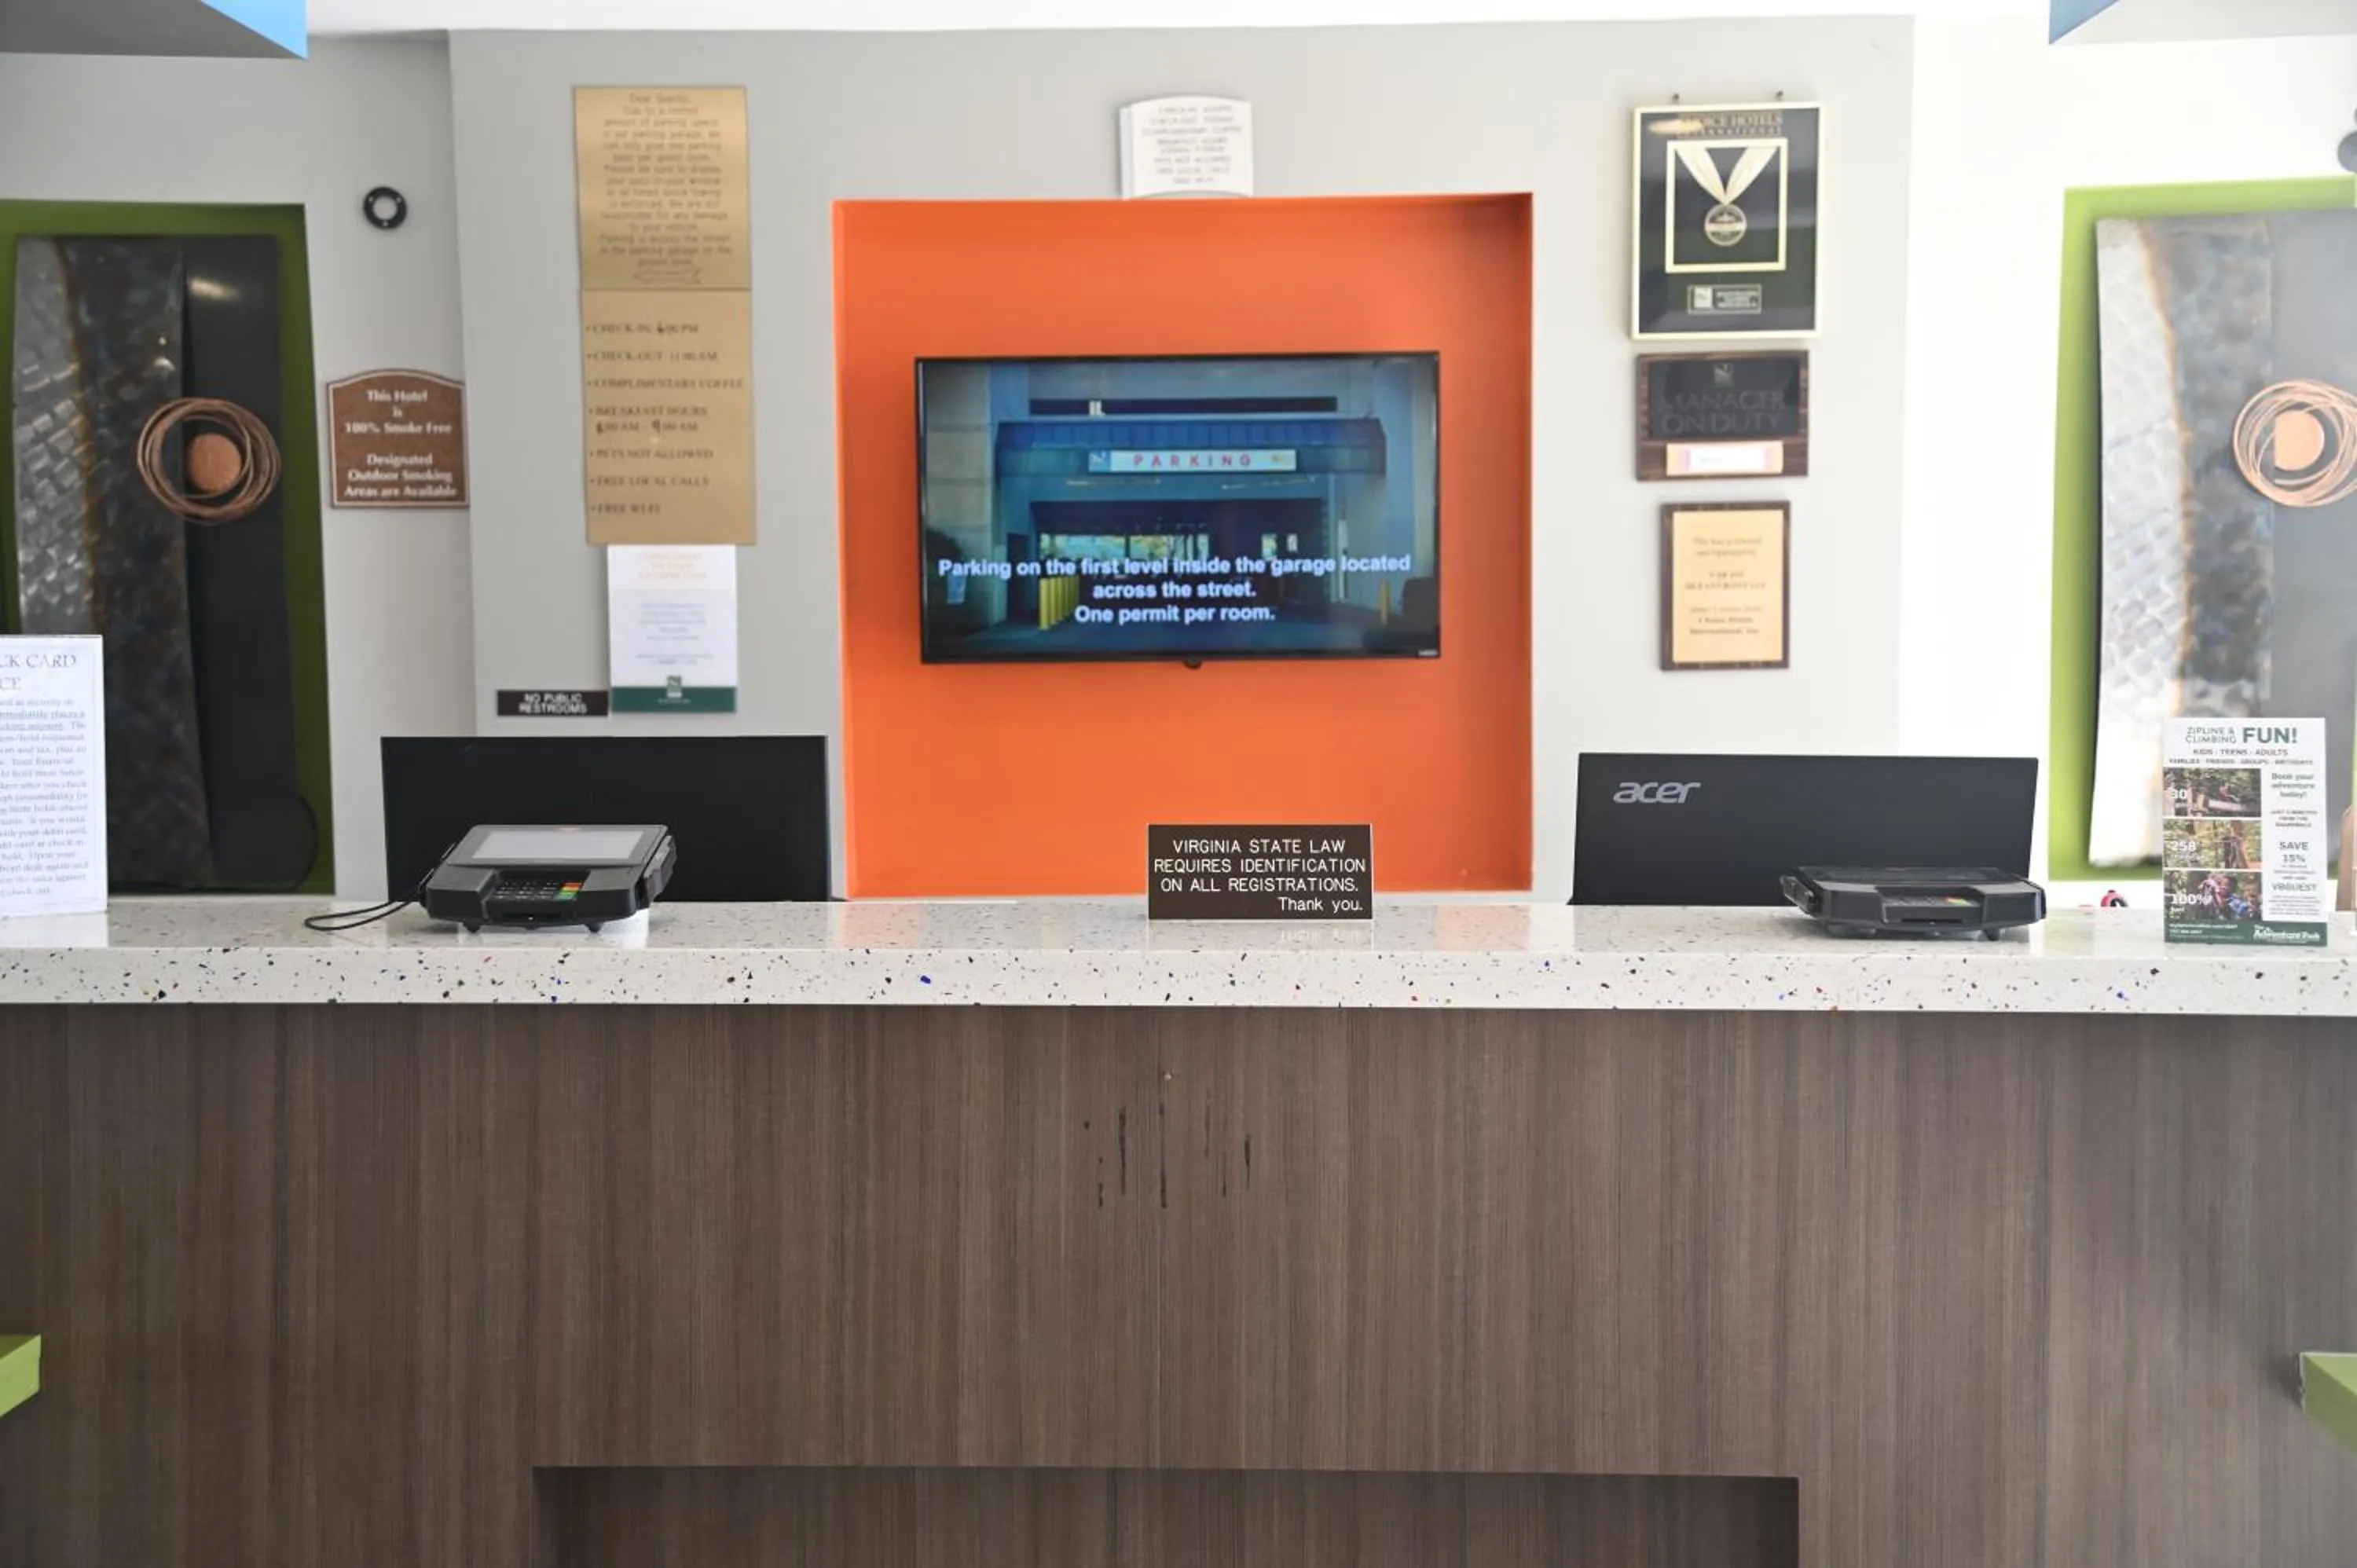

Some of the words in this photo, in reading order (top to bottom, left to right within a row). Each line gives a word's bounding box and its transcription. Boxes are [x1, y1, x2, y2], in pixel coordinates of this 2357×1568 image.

[367, 390, 392, 401] This
[394, 390, 427, 401] Hotel
[344, 422, 380, 433] 100%
[383, 422, 423, 433] Smoke
[426, 422, 452, 433] Free
[367, 454, 433, 467] Designated
[1134, 455, 1251, 467] PARKING
[347, 470, 399, 481] Outdoor
[401, 470, 453, 483] Smoking
[344, 485, 378, 497] Areas
[381, 488, 400, 497] are
[404, 485, 458, 497] Available
[939, 559, 1011, 578] Parking
[1017, 562, 1039, 574] on
[1046, 558, 1076, 574] the
[1081, 558, 1120, 574] first
[1125, 558, 1168, 574] level
[1174, 556, 1231, 573] inside
[1236, 556, 1266, 573] the
[1271, 559, 1336, 577] garage
[1341, 555, 1411, 572] located
[1093, 584, 1157, 597] across
[1162, 582, 1193, 597] the
[1197, 582, 1257, 597] street.
[1075, 606, 1113, 623] One
[1118, 606, 1178, 626] permit
[1183, 609, 1215, 626] per
[1220, 607, 1276, 621] room.
[26, 655, 77, 668] CARD
[524, 693, 541, 702] NO
[544, 693, 582, 702] PUBLIC
[519, 702, 588, 713] RESTROOMS
[2185, 735, 2237, 744] CLIMBING
[2242, 727, 2297, 744] FUN!
[1613, 782, 1701, 804] acer
[1173, 840, 1241, 854] VIRGINIA
[1249, 840, 1302, 854] STATE
[1310, 840, 1346, 854] LAW
[2278, 841, 2309, 850] SAVE
[2282, 854, 2305, 863] 15%
[1154, 859, 1231, 873] REQUIRES
[1241, 859, 1366, 873] IDENTIFICATION
[1161, 878, 1182, 892] ON
[1190, 878, 1221, 892] ALL
[1229, 878, 1358, 892] REGISTRATIONS.
[1278, 896, 1324, 911] Thank
[1332, 899, 1364, 914] you.
